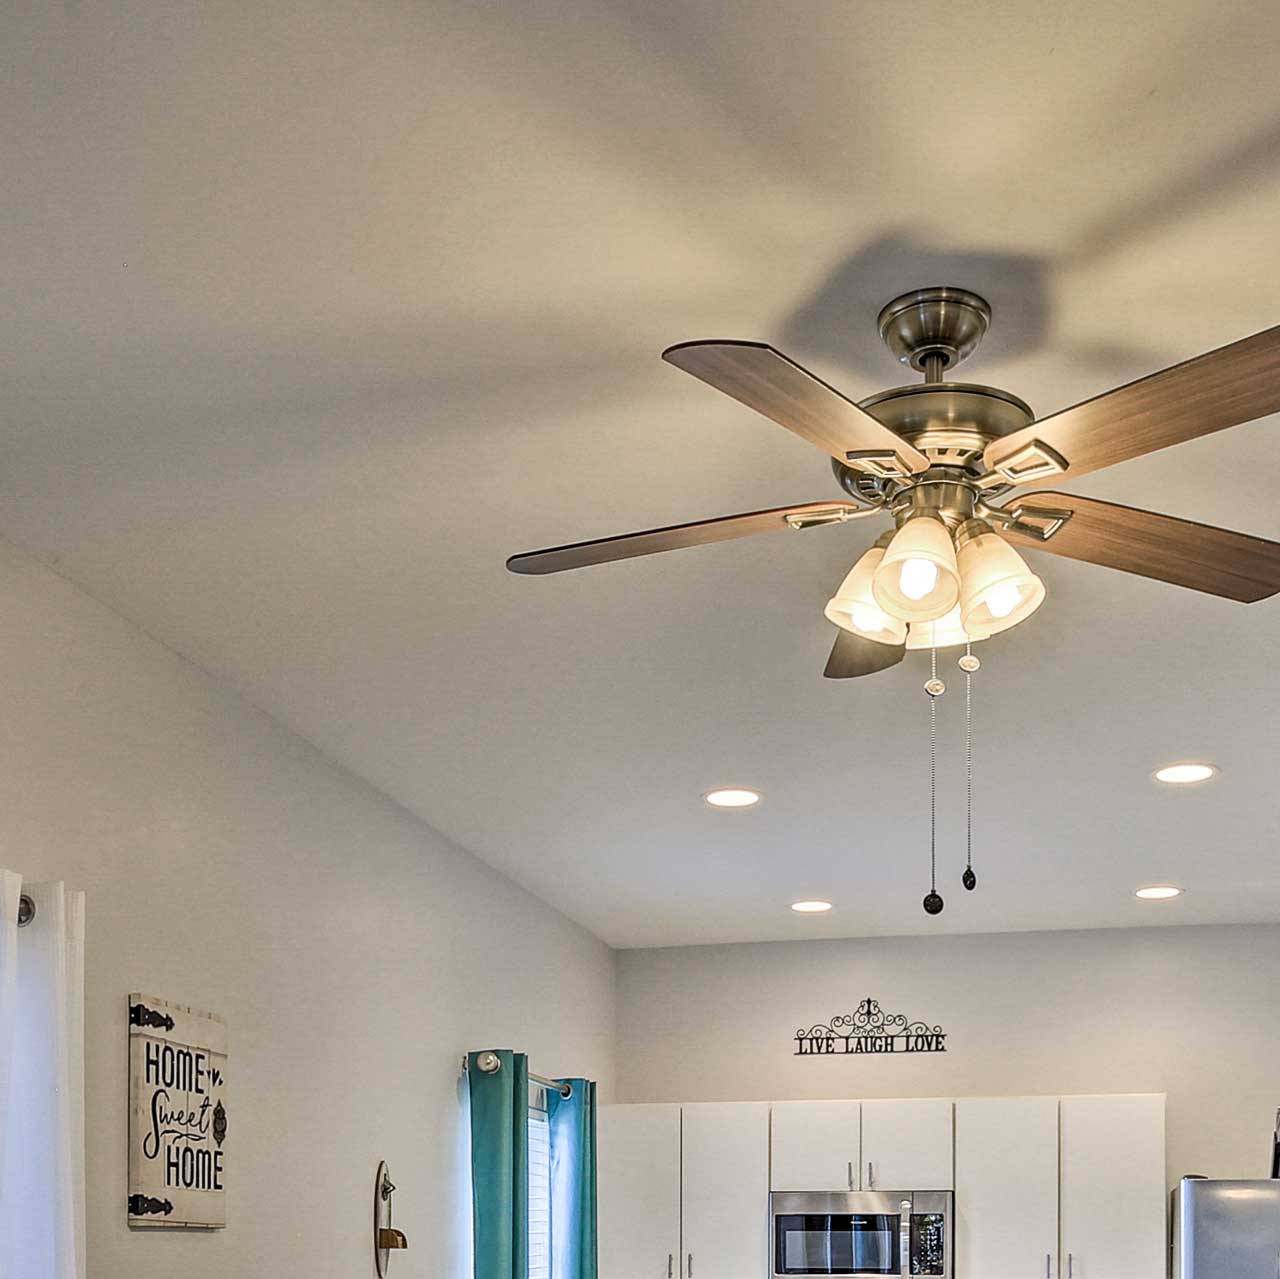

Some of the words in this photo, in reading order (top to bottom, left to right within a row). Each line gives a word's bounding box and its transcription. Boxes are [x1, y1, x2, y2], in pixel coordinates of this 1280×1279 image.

[145, 1041, 206, 1095] HOME
[798, 1037, 835, 1054] LIVE
[845, 1036, 894, 1053] LAUGH
[905, 1034, 945, 1051] LOVE
[143, 1088, 213, 1160] Sweet
[166, 1145, 223, 1190] HOME
